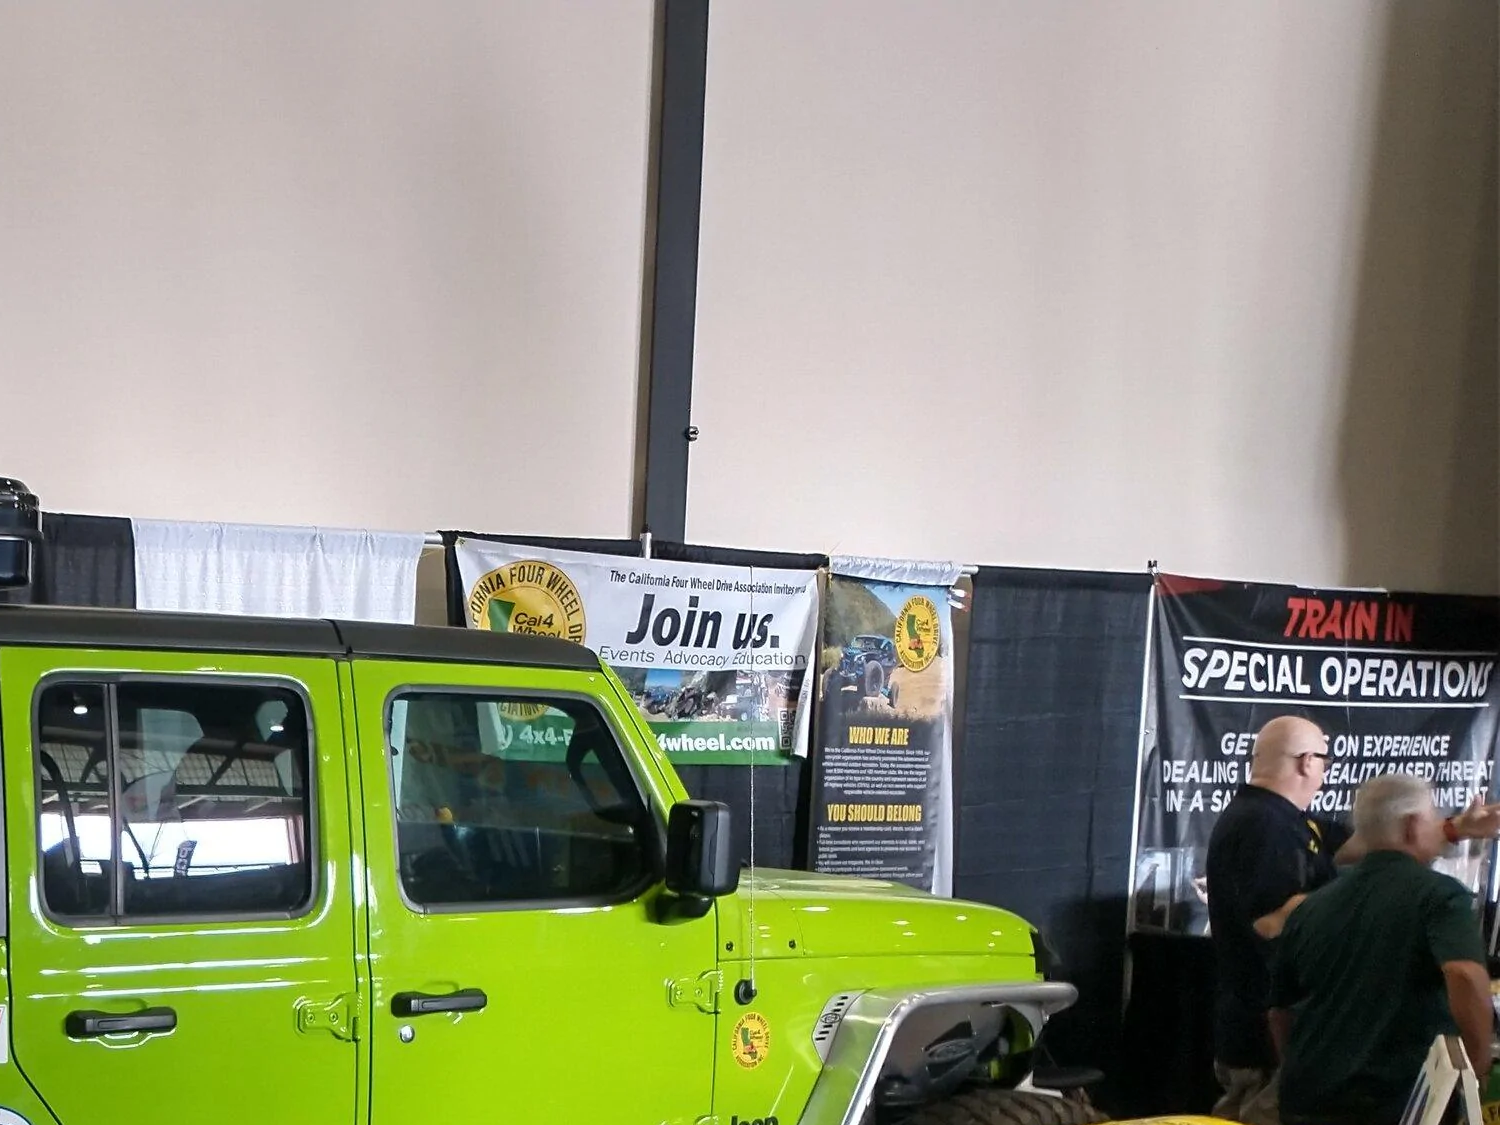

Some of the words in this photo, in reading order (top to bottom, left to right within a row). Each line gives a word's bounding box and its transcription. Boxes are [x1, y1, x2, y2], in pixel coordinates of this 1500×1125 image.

[510, 565, 546, 586] FOUR
[546, 571, 580, 622] WHEEL
[609, 570, 627, 583] The
[628, 573, 671, 587] California
[671, 575, 689, 589] Four
[690, 577, 715, 591] Wheel
[716, 579, 733, 592] Drive
[733, 581, 773, 595] Association
[514, 612, 554, 629] Cal4
[625, 593, 722, 650] Join
[732, 613, 780, 650] us.
[1284, 597, 1379, 642] TRAIN
[1384, 604, 1414, 643] IN
[599, 645, 656, 664] Events
[663, 650, 730, 669] Advocacy
[732, 652, 806, 666] Education
[1182, 647, 1311, 695] SPECIAL
[1320, 655, 1494, 699] OPERATIONS
[653, 733, 776, 751] 4wheel.com
[849, 726, 874, 745] WHO
[874, 727, 891, 745] WE
[891, 728, 910, 746] ARE
[1333, 735, 1360, 757] ON
[1363, 735, 1451, 757] EXPERIENCE
[1163, 760, 1238, 784] DEALING
[827, 804, 847, 822] YOU
[848, 804, 885, 822] SHOULD
[886, 805, 922, 822] BELONG
[1166, 790, 1184, 812] IN
[1188, 790, 1204, 812] A
